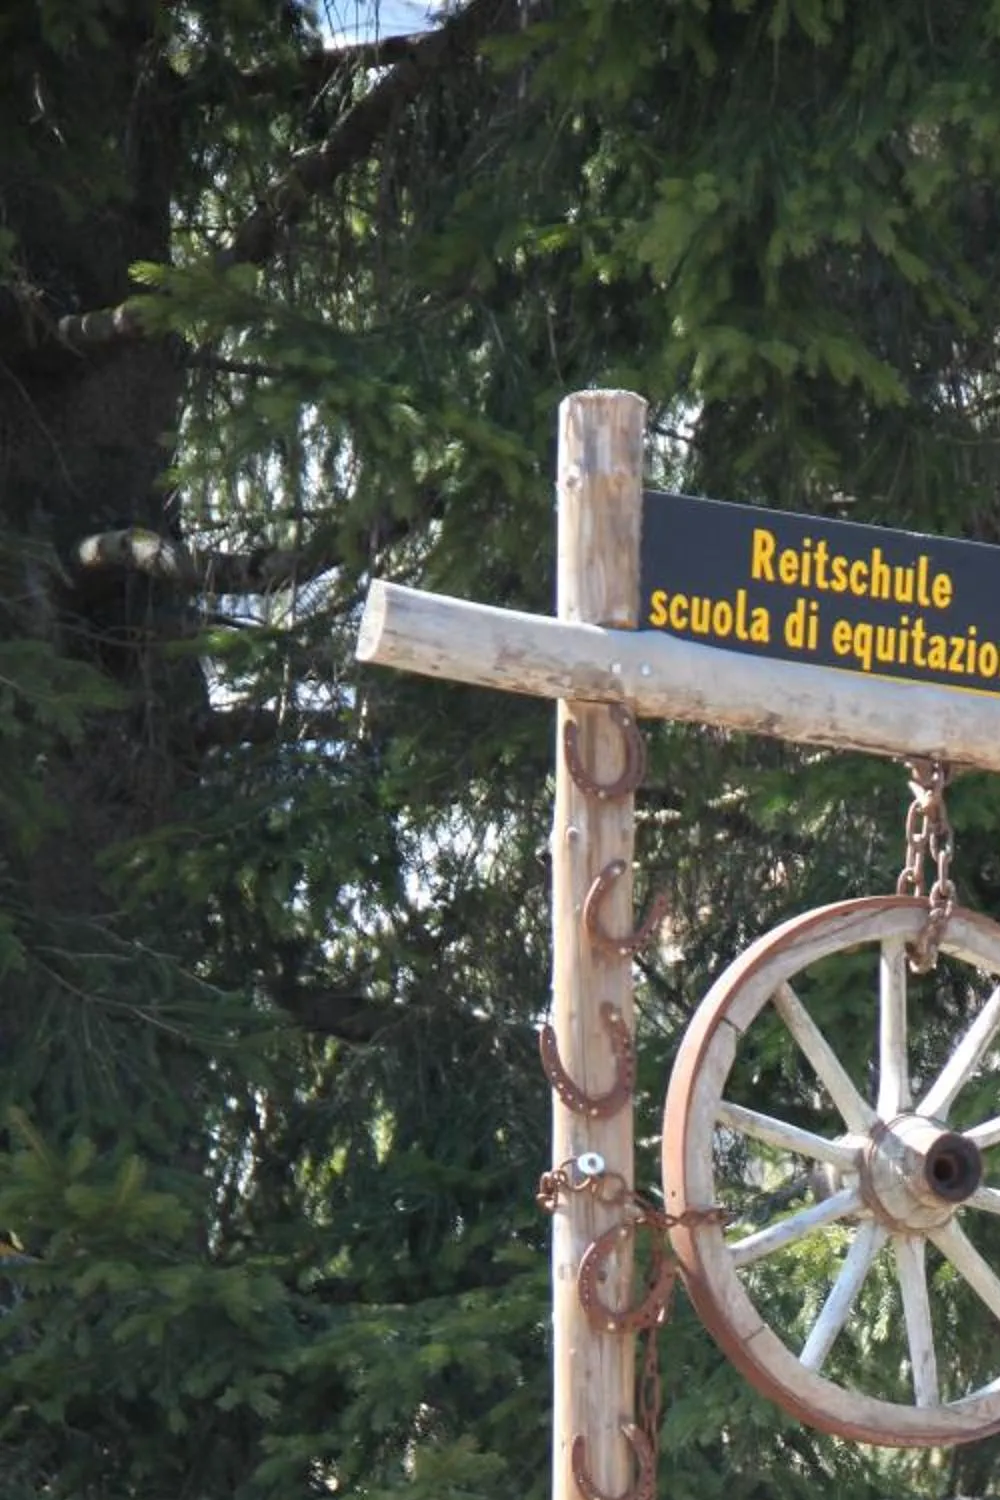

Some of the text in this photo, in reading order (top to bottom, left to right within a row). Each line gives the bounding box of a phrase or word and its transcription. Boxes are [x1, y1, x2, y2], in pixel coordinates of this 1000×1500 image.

[751, 528, 952, 609] Reitschule
[650, 590, 770, 644] scuola
[784, 598, 819, 649] di
